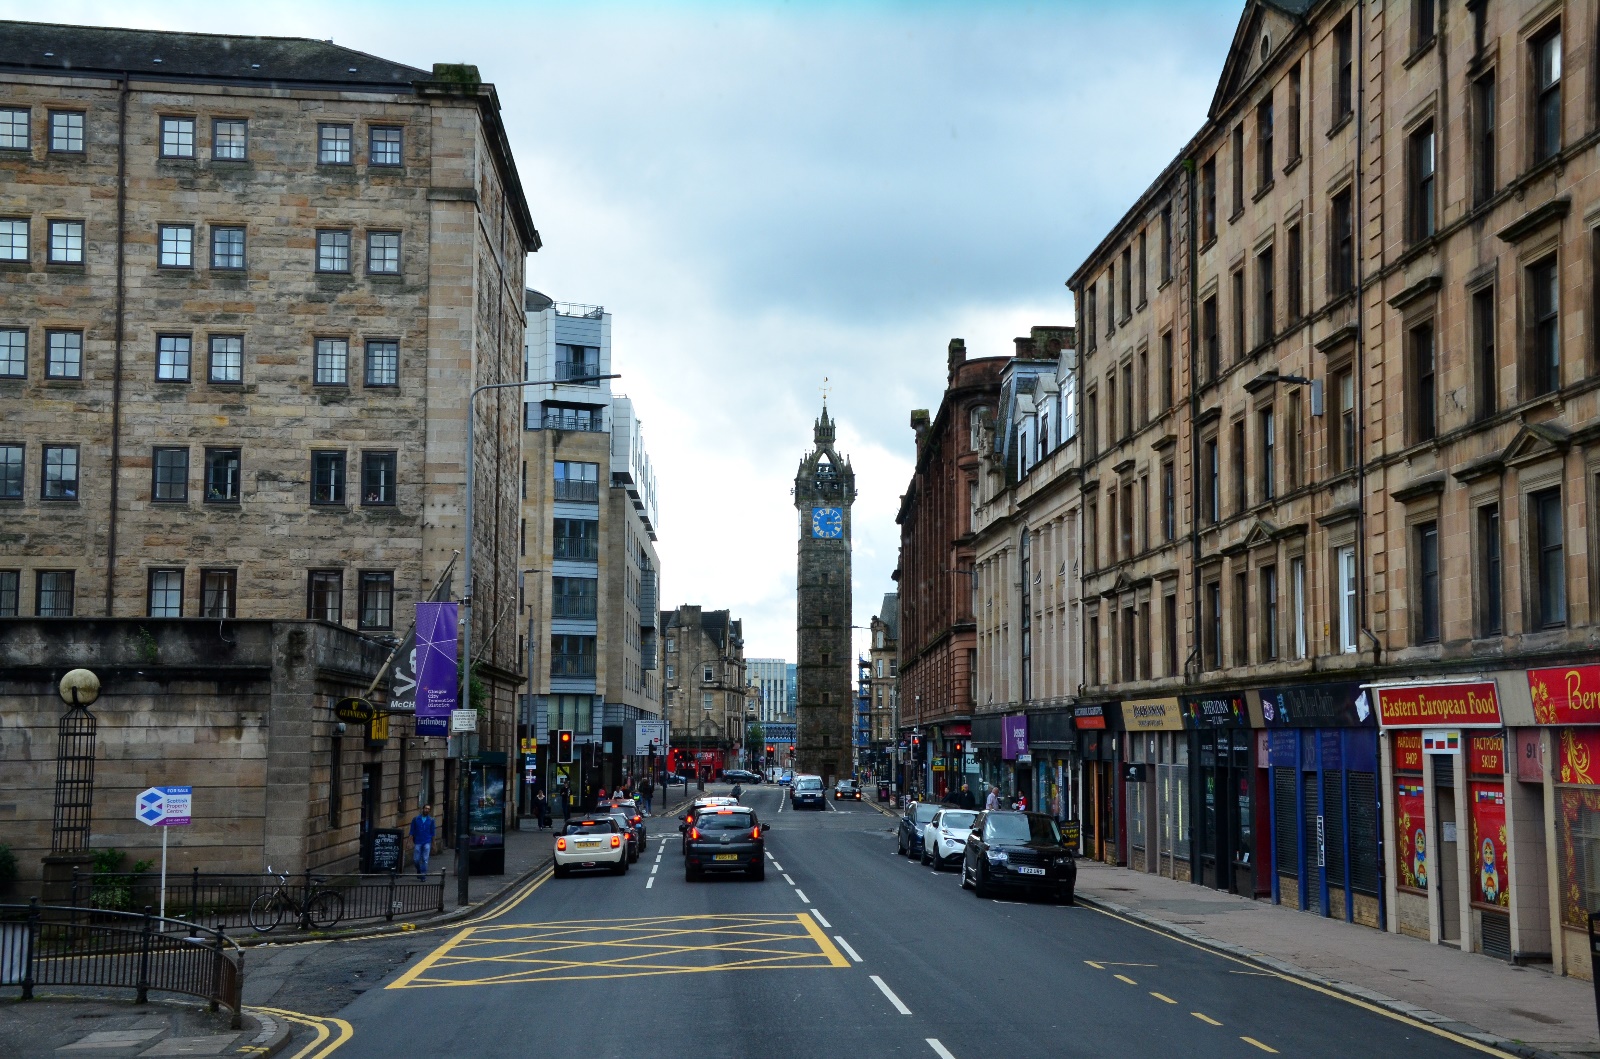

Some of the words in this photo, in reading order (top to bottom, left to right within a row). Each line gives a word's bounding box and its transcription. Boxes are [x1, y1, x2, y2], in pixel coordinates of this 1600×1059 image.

[1381, 696, 1418, 717] Eastern
[1418, 694, 1467, 719] European
[1467, 691, 1496, 715] Food
[339, 709, 368, 719] GUINNESS
[1526, 742, 1537, 759] 91
[1405, 752, 1418, 765] SHOP
[1481, 754, 1498, 768] SKLEP
